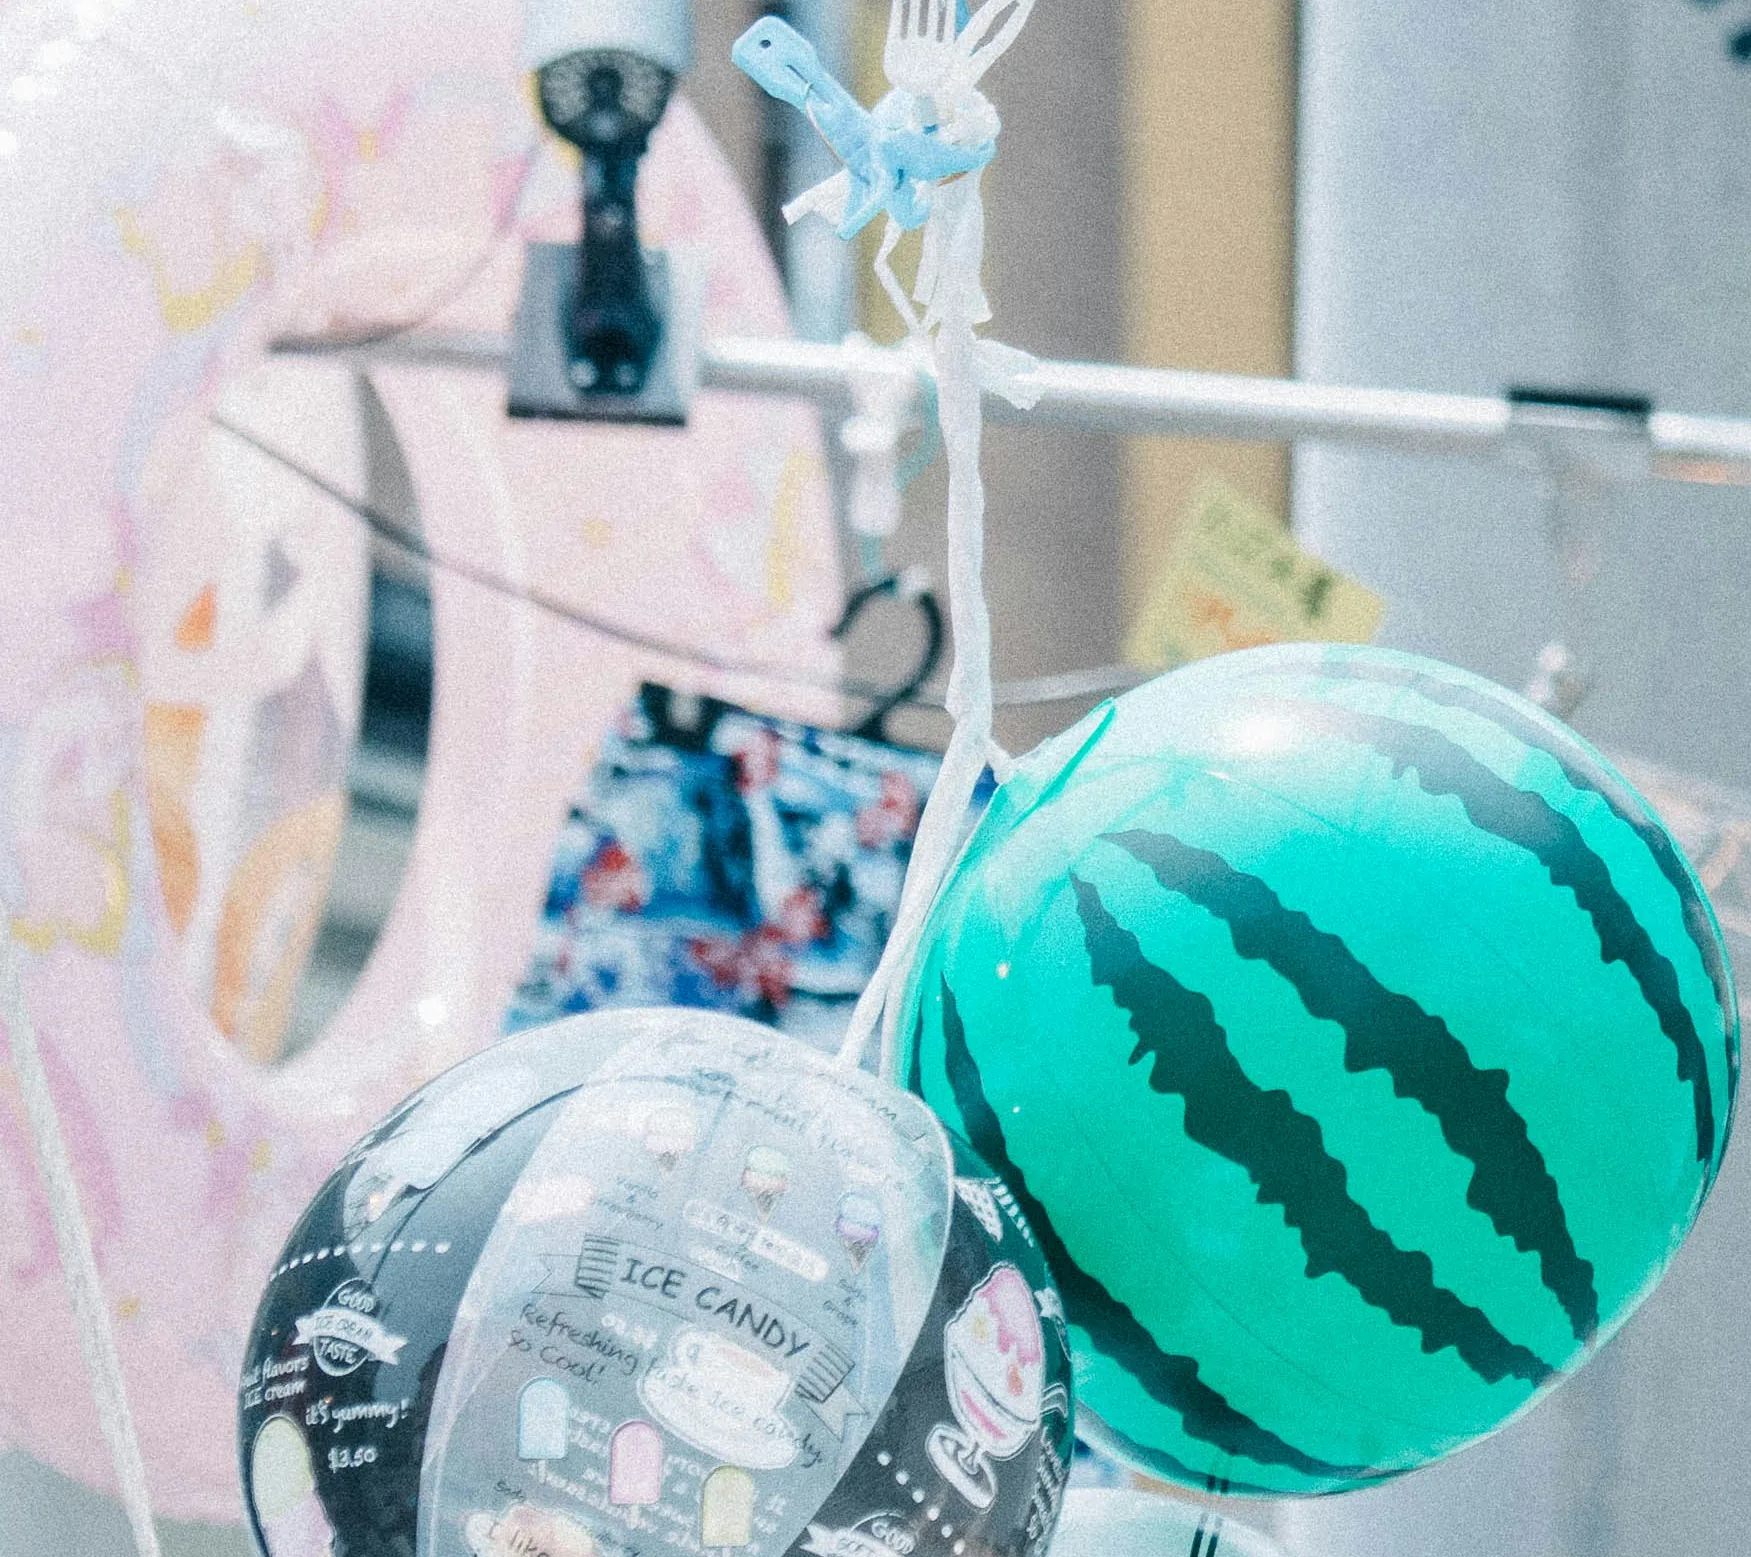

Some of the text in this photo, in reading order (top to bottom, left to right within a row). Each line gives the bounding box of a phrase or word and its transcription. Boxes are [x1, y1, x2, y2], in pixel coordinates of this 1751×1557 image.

[337, 1289, 377, 1313] GOOD
[618, 1256, 689, 1302] ICE
[693, 1284, 812, 1360] CANDY
[318, 1338, 361, 1365] TASTE
[519, 1301, 642, 1378] Refreshing
[262, 1355, 311, 1389] flavors
[264, 1378, 309, 1402] cream
[331, 1396, 411, 1435] yummy!
